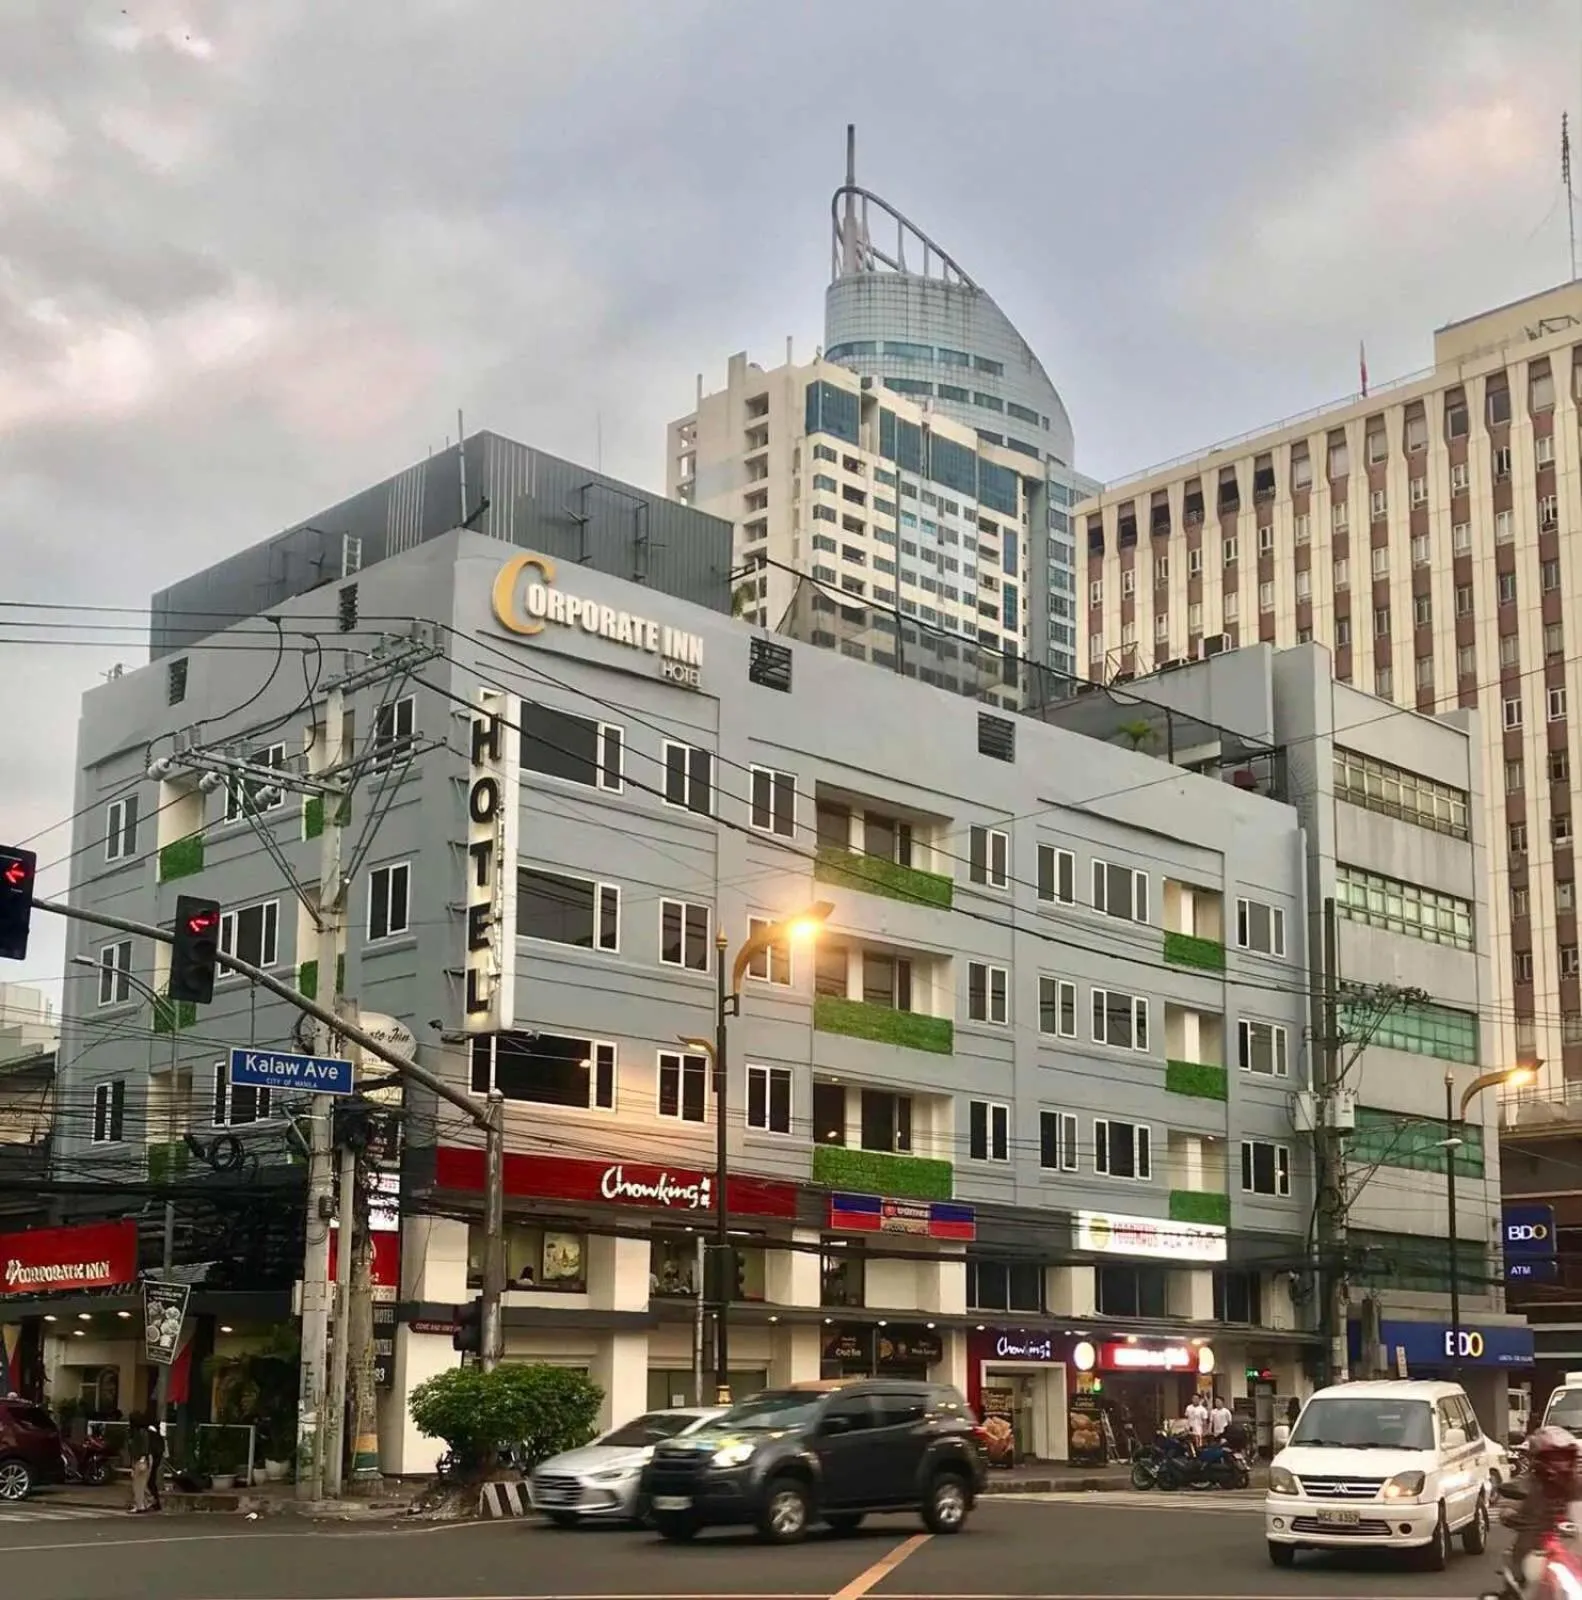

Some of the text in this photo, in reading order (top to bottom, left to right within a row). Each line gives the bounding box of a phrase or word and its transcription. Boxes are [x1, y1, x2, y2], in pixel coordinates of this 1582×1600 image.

[492, 555, 704, 667] CORPORATE INN
[663, 661, 701, 686] HOTEL
[466, 713, 501, 1014] HOTEL
[245, 1054, 339, 1080] Kalaw Ave
[266, 1077, 281, 1085] CITY
[294, 1080, 318, 1088] MANILA
[601, 1165, 699, 1209] Chowking
[1508, 1224, 1548, 1240] BDO
[85, 1260, 110, 1280] INN
[1510, 1265, 1532, 1275] ATM
